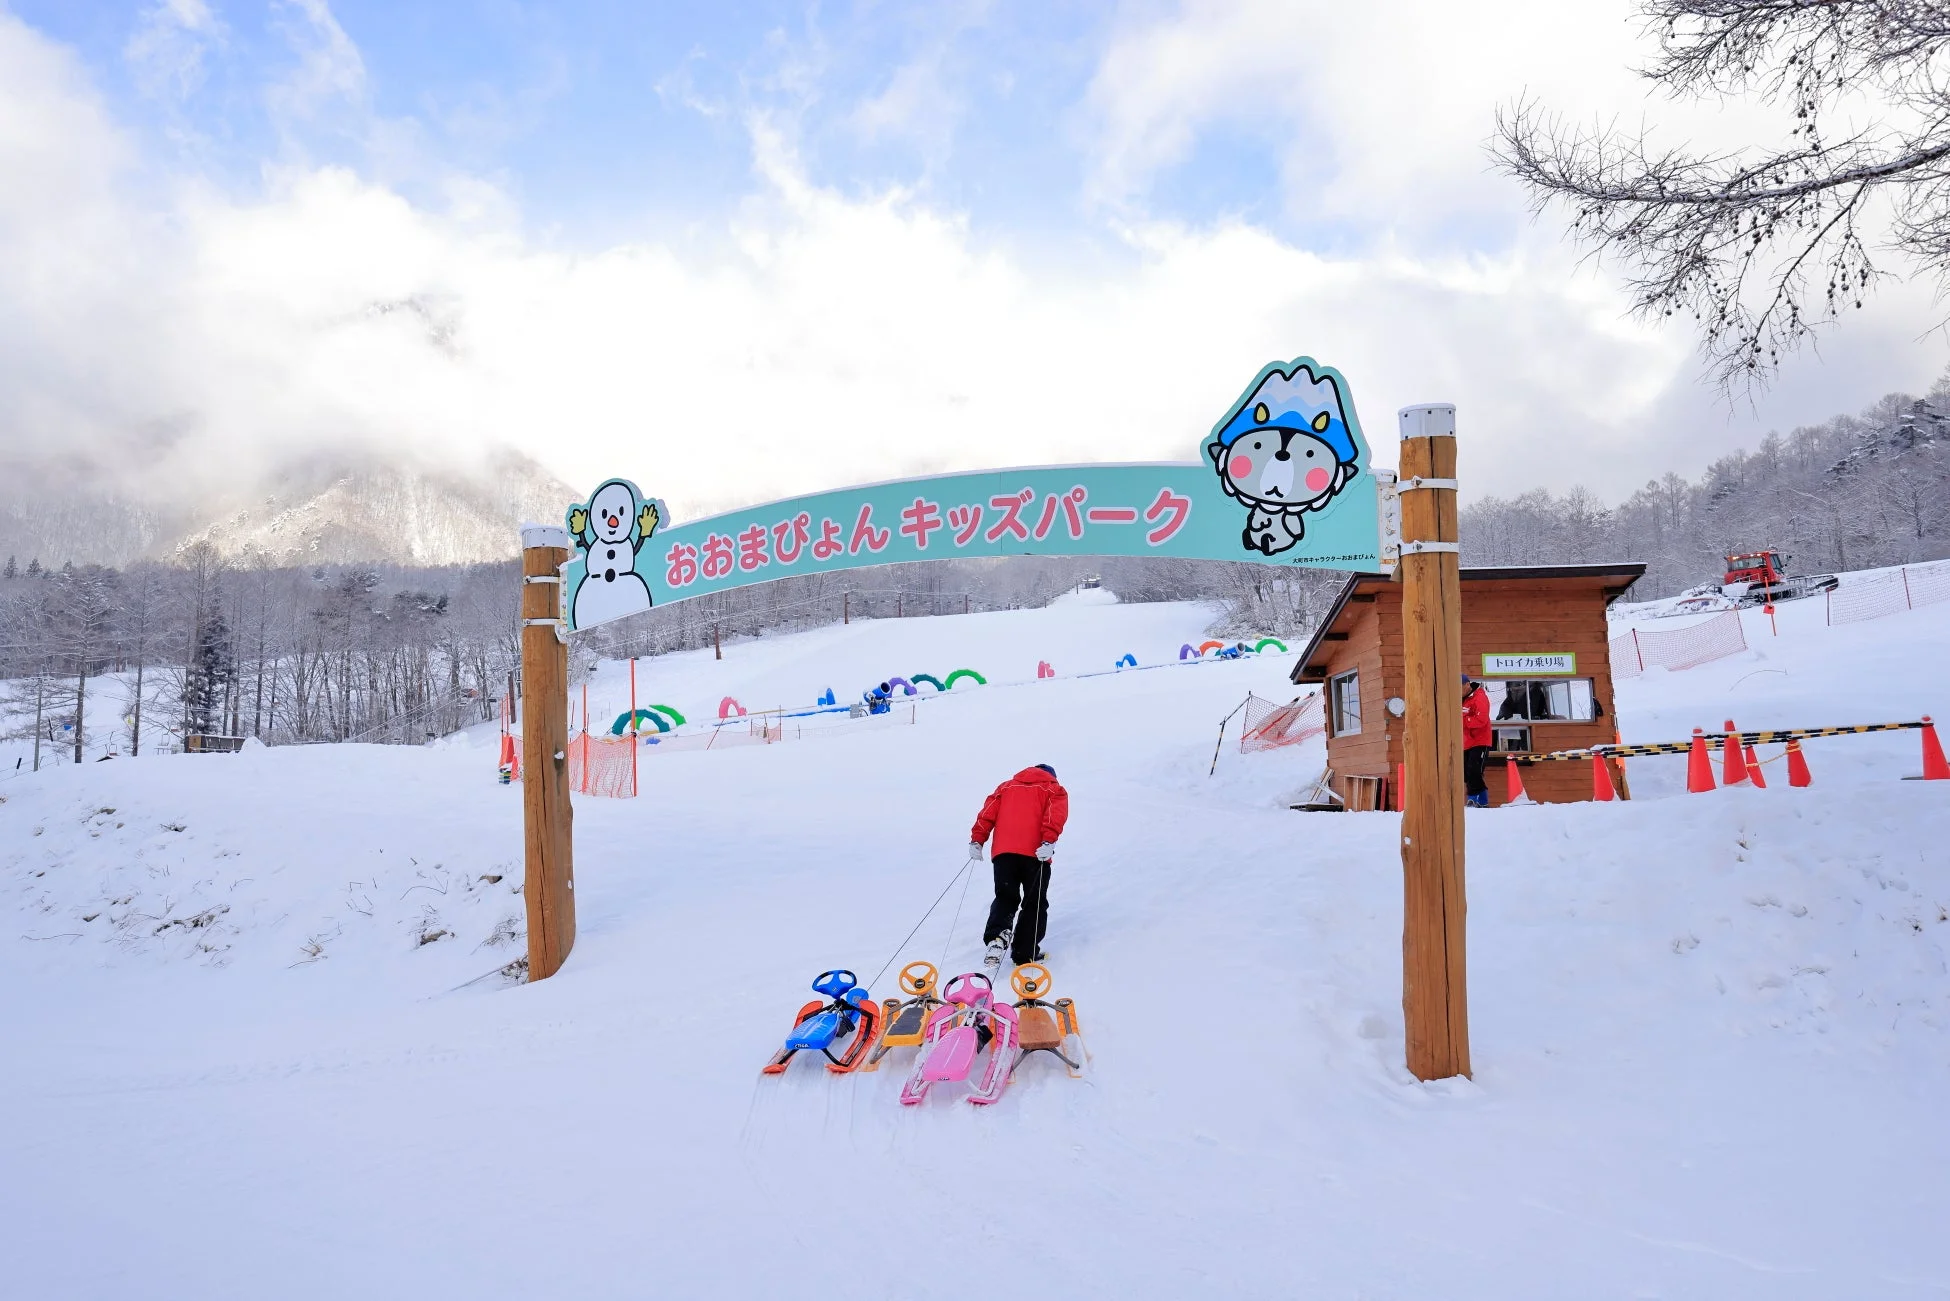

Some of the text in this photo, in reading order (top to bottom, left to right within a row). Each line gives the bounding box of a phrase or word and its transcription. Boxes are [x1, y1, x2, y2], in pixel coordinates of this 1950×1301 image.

[1496, 656, 1565, 667] トロイカ乗り場
